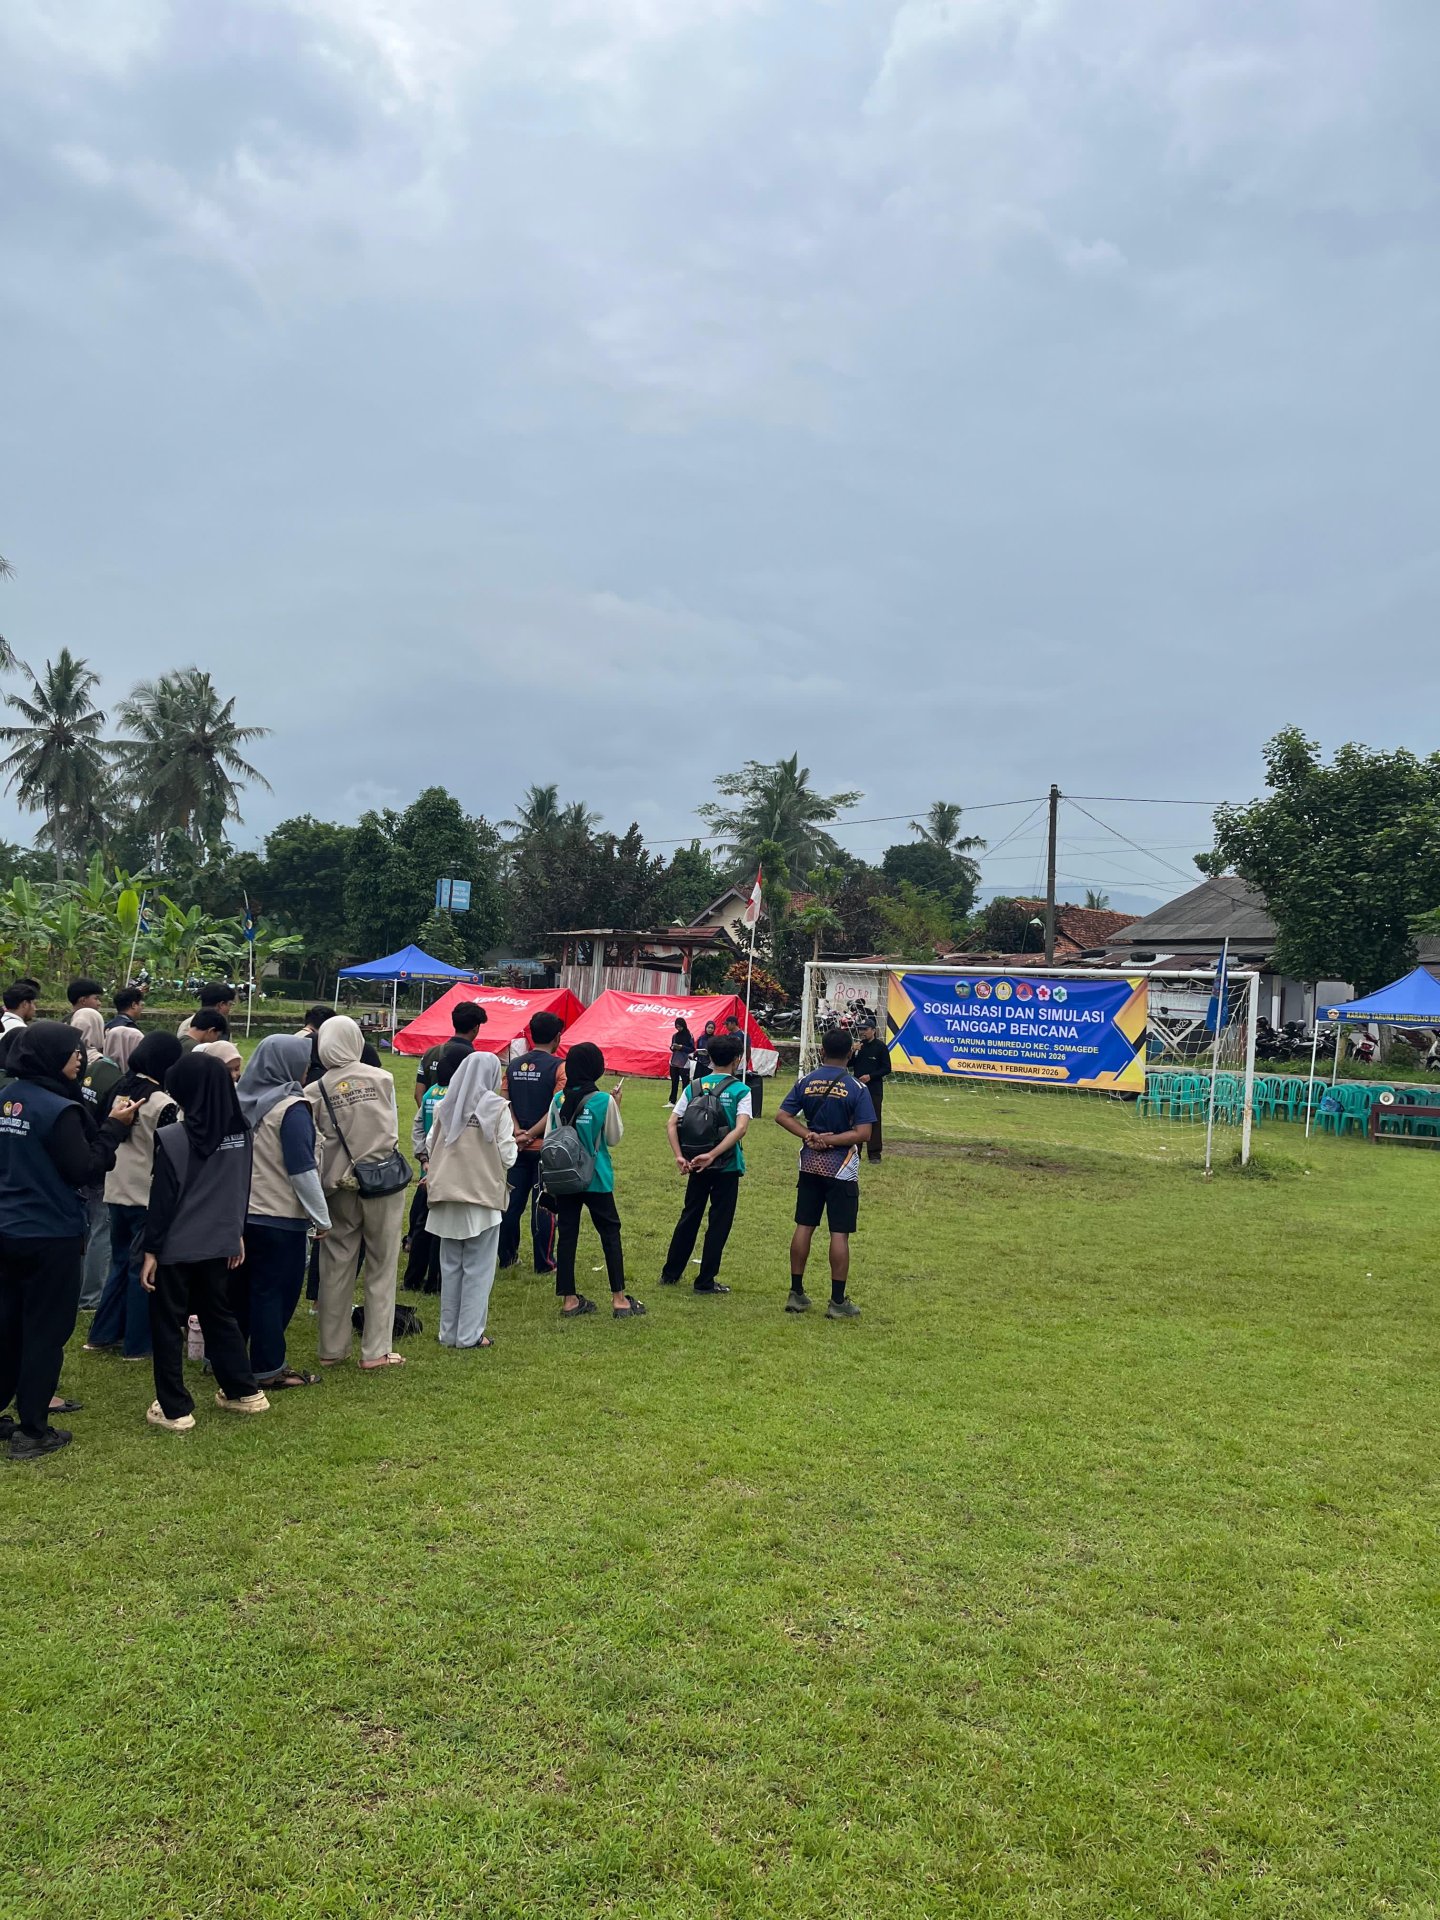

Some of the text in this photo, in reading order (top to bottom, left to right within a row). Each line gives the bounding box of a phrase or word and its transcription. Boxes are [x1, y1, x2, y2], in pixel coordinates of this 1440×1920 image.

[625, 1003, 695, 1018] KEMENSOS
[923, 1002, 1105, 1023] SOSIALISASI DAN SIMULASI
[1346, 1011, 1370, 1019] KARANG
[1372, 1012, 1394, 1020] TARUNA
[1396, 1014, 1428, 1022] BUMIREDJO
[945, 1019, 1078, 1039] TANGGAP BENCANA
[923, 1035, 1099, 1054] KARANG TARUNA BUMIREDJO KEC. SOMAGEDE
[953, 1045, 1066, 1061] DAN KKN UNSOED TAHUN 2026
[957, 1061, 1059, 1076] SOKAWERA, 1 FEBRUARI 2026
